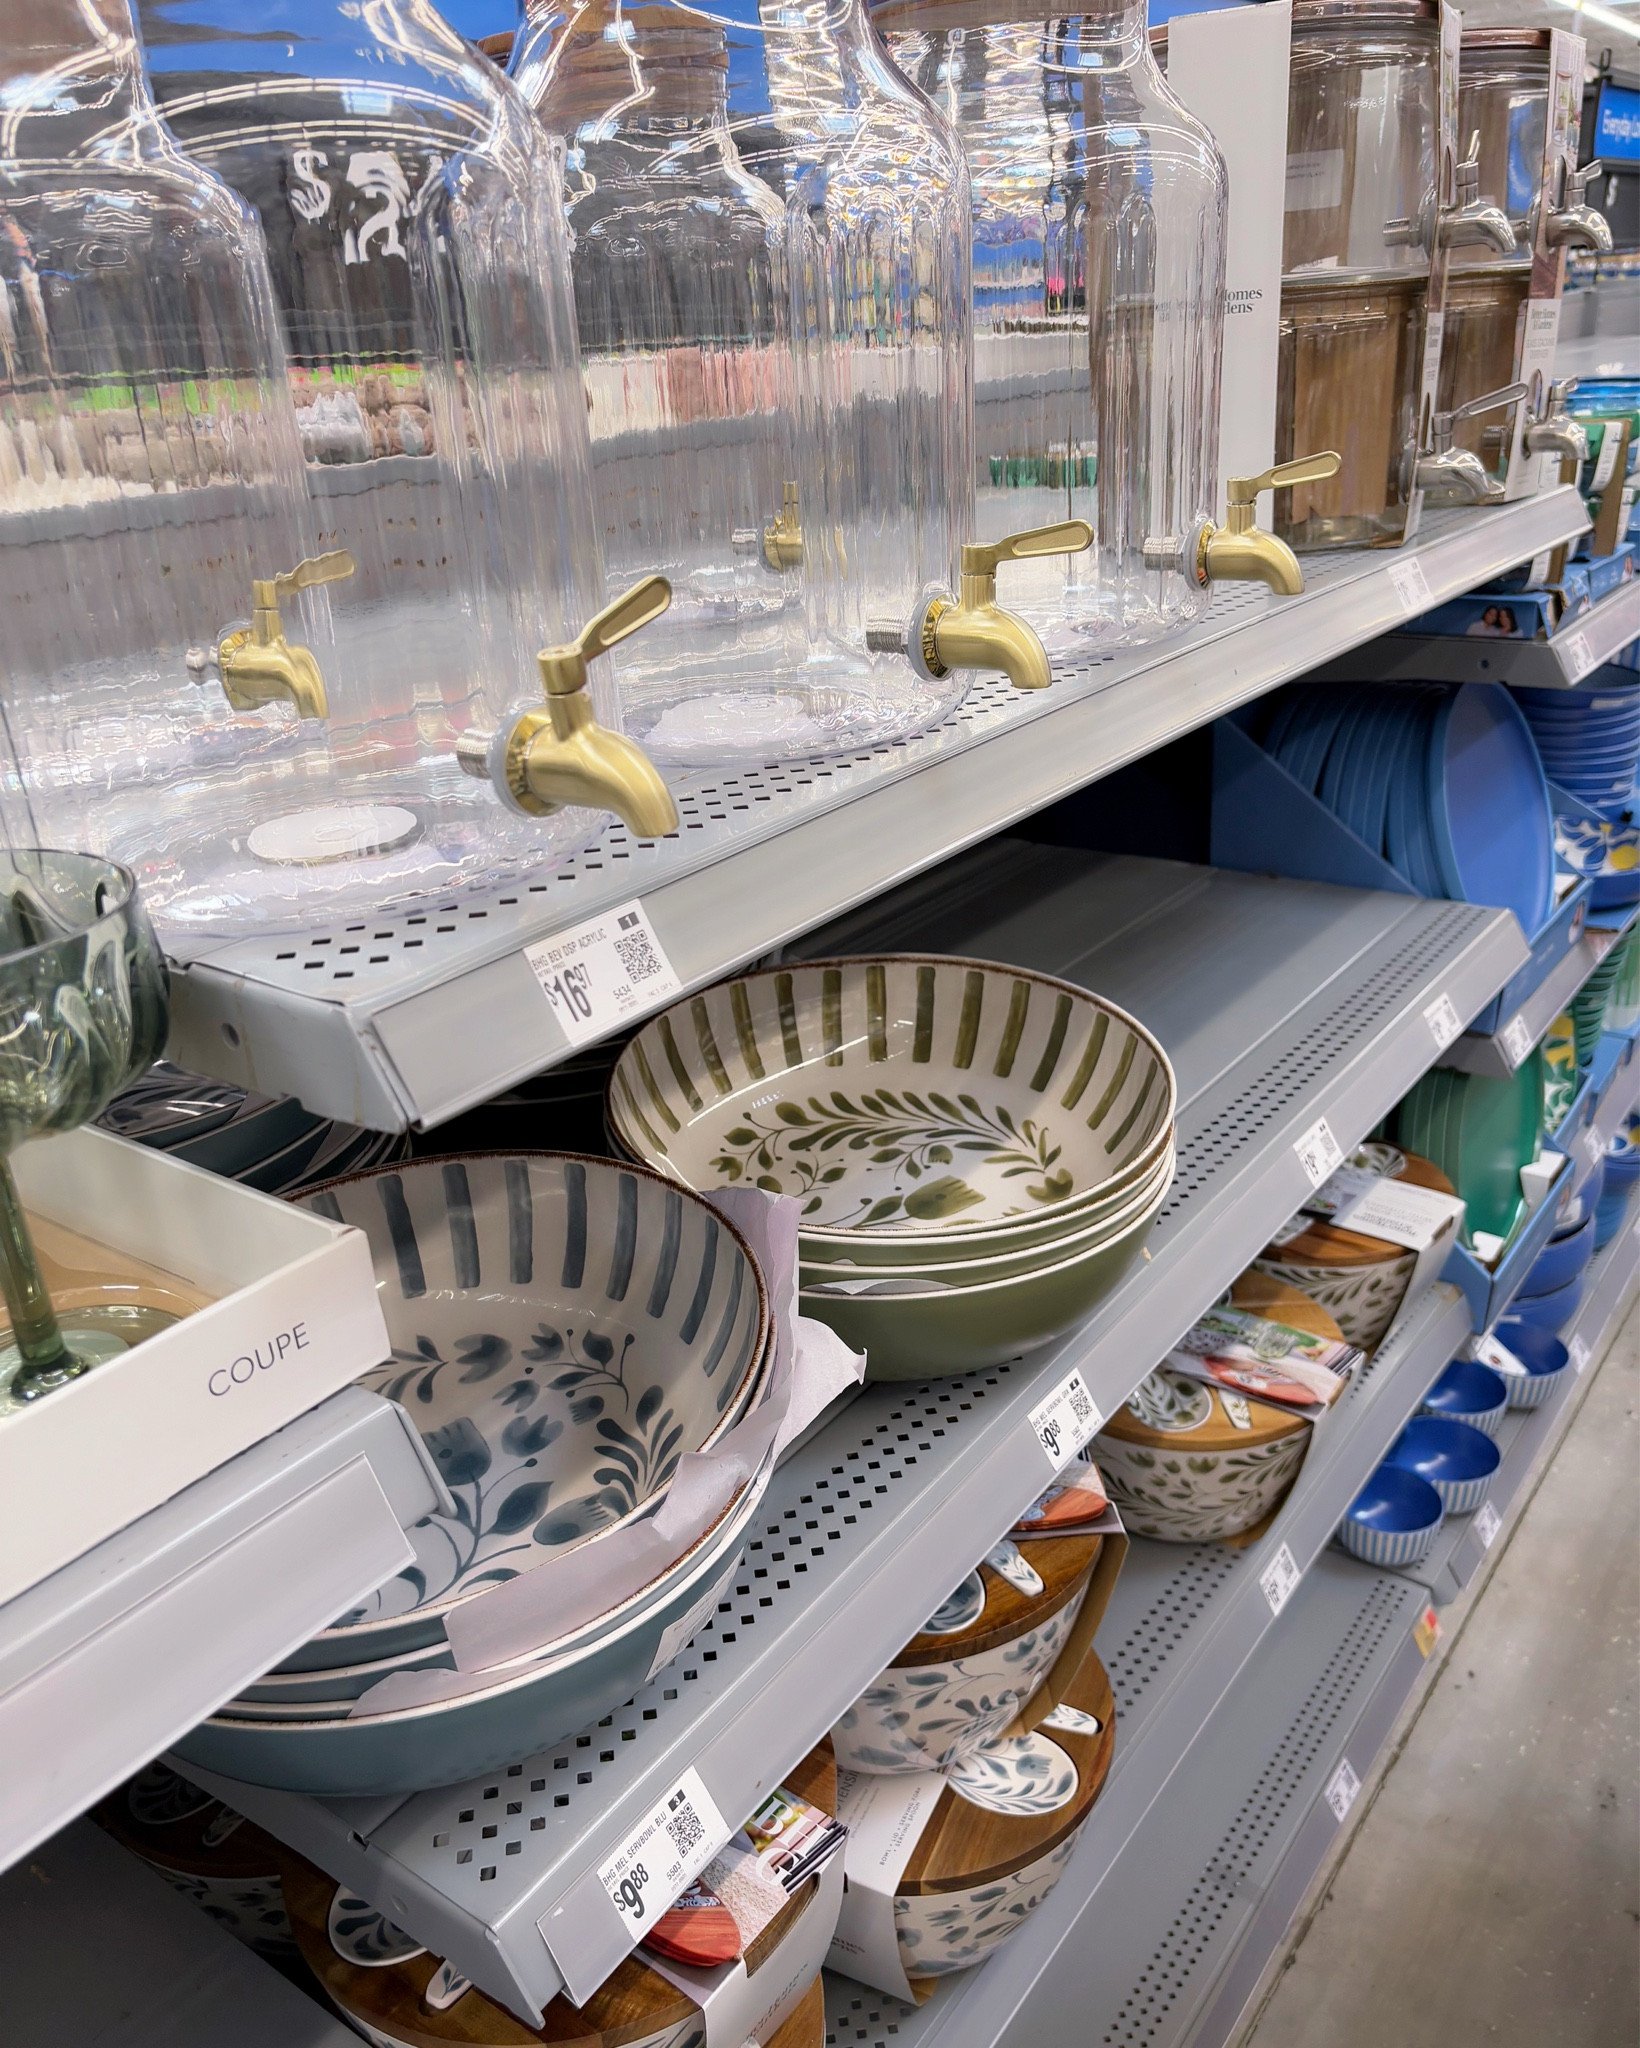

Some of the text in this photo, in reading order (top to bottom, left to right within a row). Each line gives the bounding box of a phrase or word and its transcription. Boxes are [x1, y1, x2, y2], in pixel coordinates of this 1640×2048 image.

[549, 949, 563, 964] BEV
[564, 942, 577, 957] DSP
[578, 928, 608, 949] ACRYLIC
[612, 984, 632, 1000] 5434
[208, 1321, 310, 1397] COUPE
[1040, 1419, 1061, 1457] $988
[602, 1811, 667, 1886] BHG MEL SERVBOWL BLU
[896, 1823, 910, 1847] SERVING
[667, 1861, 682, 1880] 5503
[613, 1862, 649, 1919] $988
